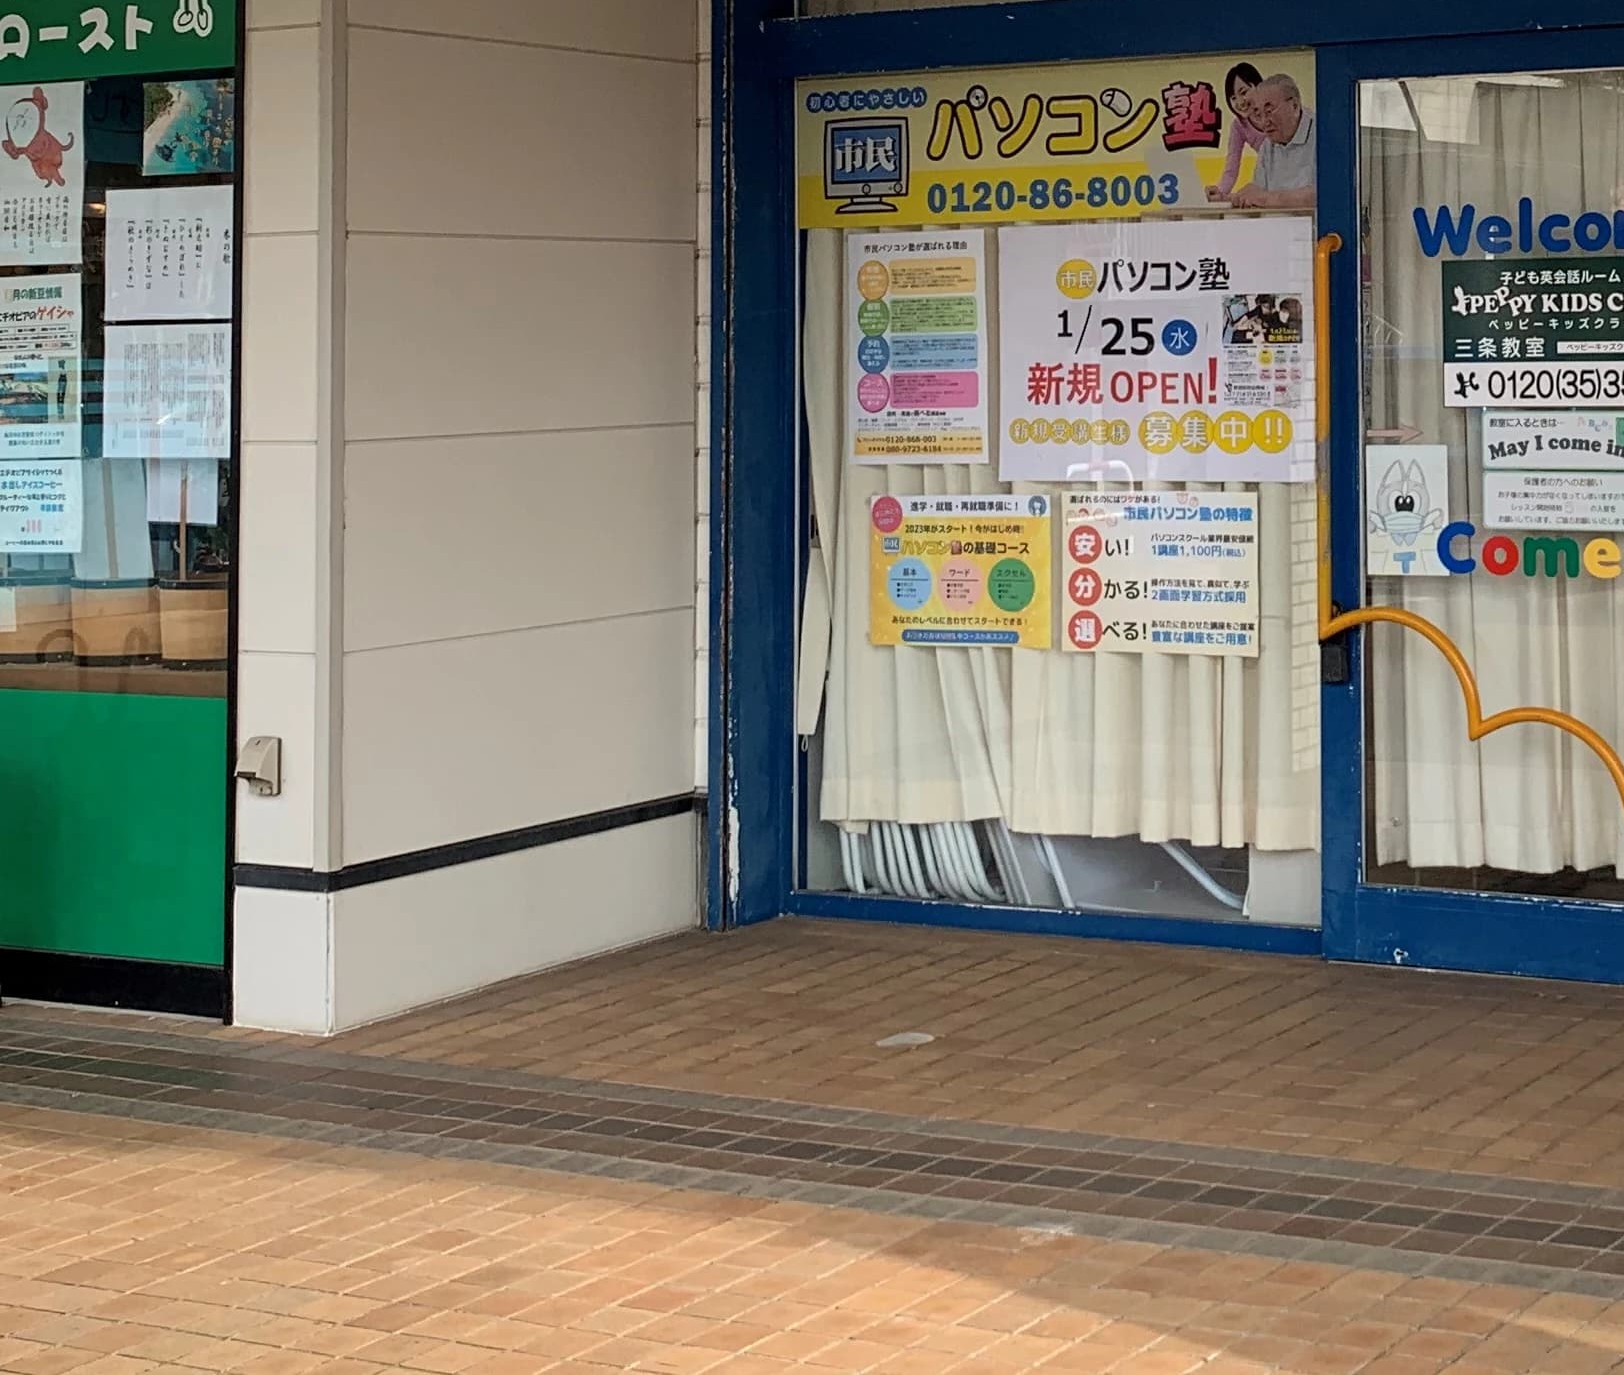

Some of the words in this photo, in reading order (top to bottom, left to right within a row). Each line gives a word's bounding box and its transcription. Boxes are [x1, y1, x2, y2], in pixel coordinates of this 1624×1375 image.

[926, 81, 1222, 162] パソコン塾
[834, 135, 897, 174] 市民
[927, 173, 1180, 214] 0120-86-8003
[1061, 271, 1095, 290] 市民
[1097, 257, 1231, 294] パソコン塾
[1499, 269, 1622, 286] 子ども英会話ルーム
[1468, 286, 1537, 317] PEPPY
[1541, 292, 1603, 313] KIDS
[1056, 304, 1156, 357] 1/25
[1170, 327, 1191, 349] 水
[1454, 336, 1546, 359] 三条教室
[1488, 439, 1530, 461] May
[1534, 435, 1544, 451] I
[1548, 437, 1602, 452] come
[1437, 521, 1622, 579] Come
[1074, 575, 1148, 600] 分かる!
[1074, 618, 1147, 643] 選べる!
